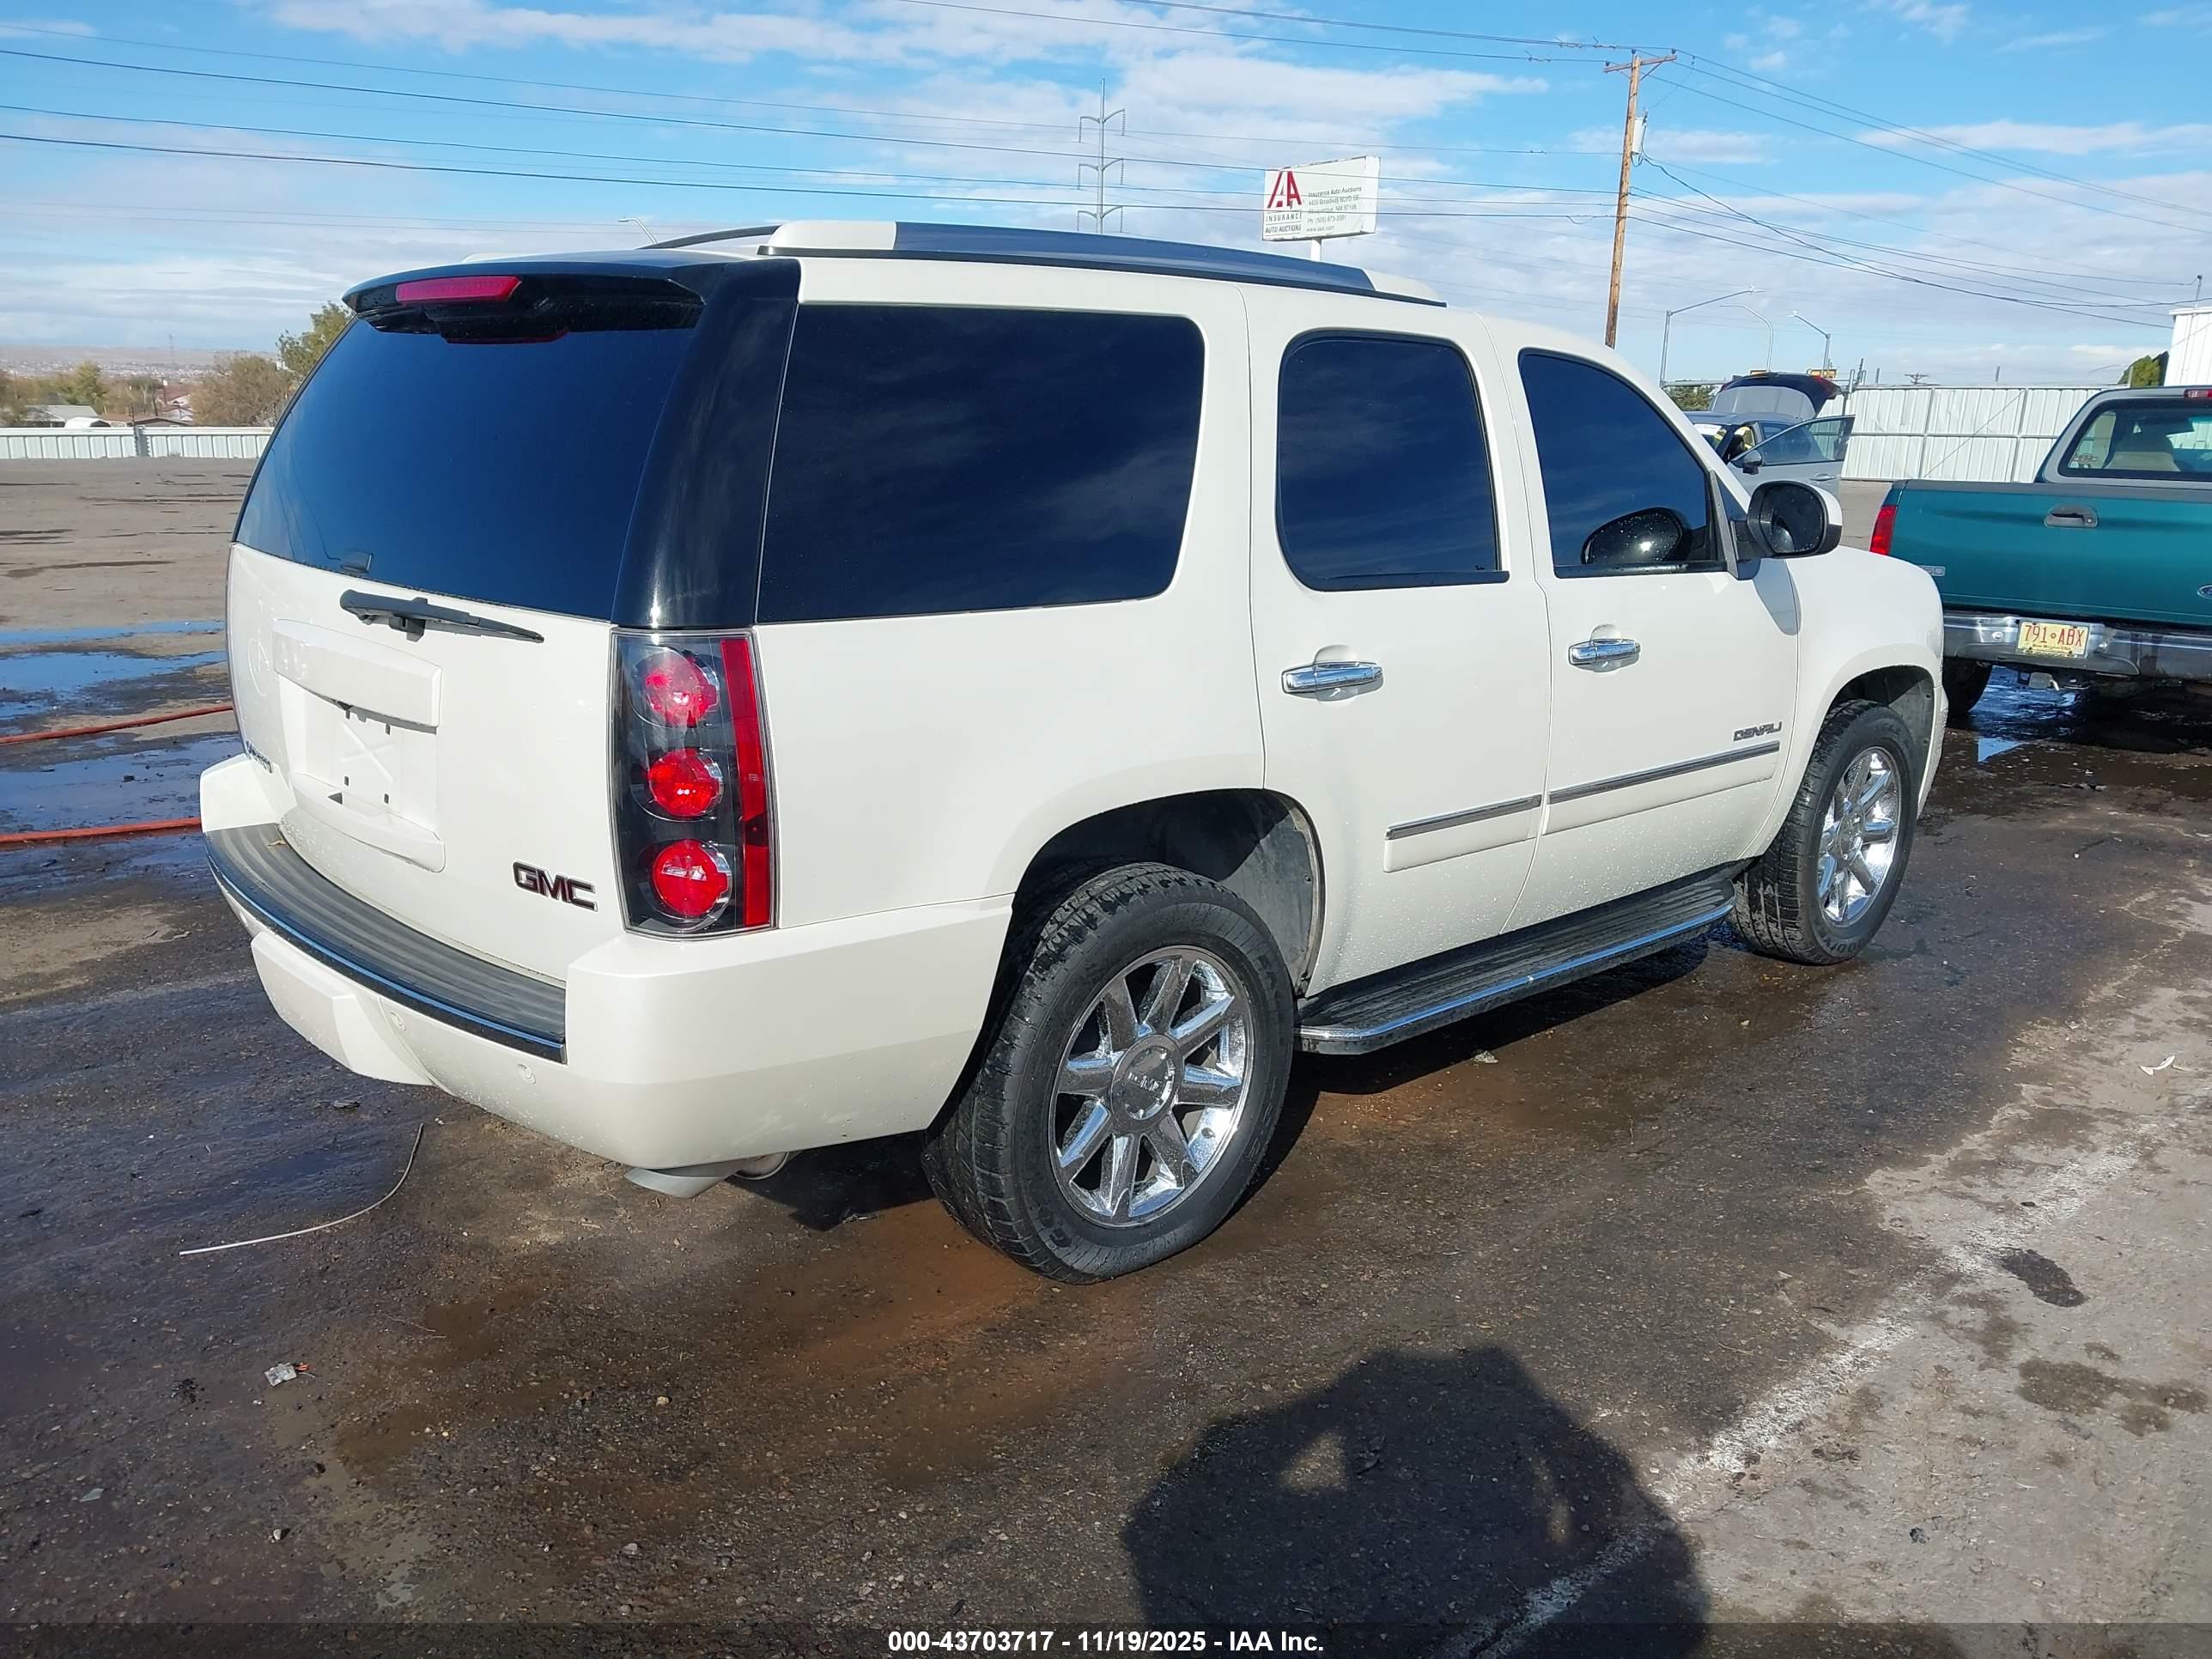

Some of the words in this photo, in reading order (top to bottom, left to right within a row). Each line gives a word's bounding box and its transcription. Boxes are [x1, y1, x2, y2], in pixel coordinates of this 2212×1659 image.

[1265, 212, 1303, 222] INSURANCE
[1265, 226, 1279, 234] AUTO
[1279, 223, 1303, 233] AUCTIONS
[1733, 721, 1783, 742] DENALI
[513, 860, 599, 912] GMC
